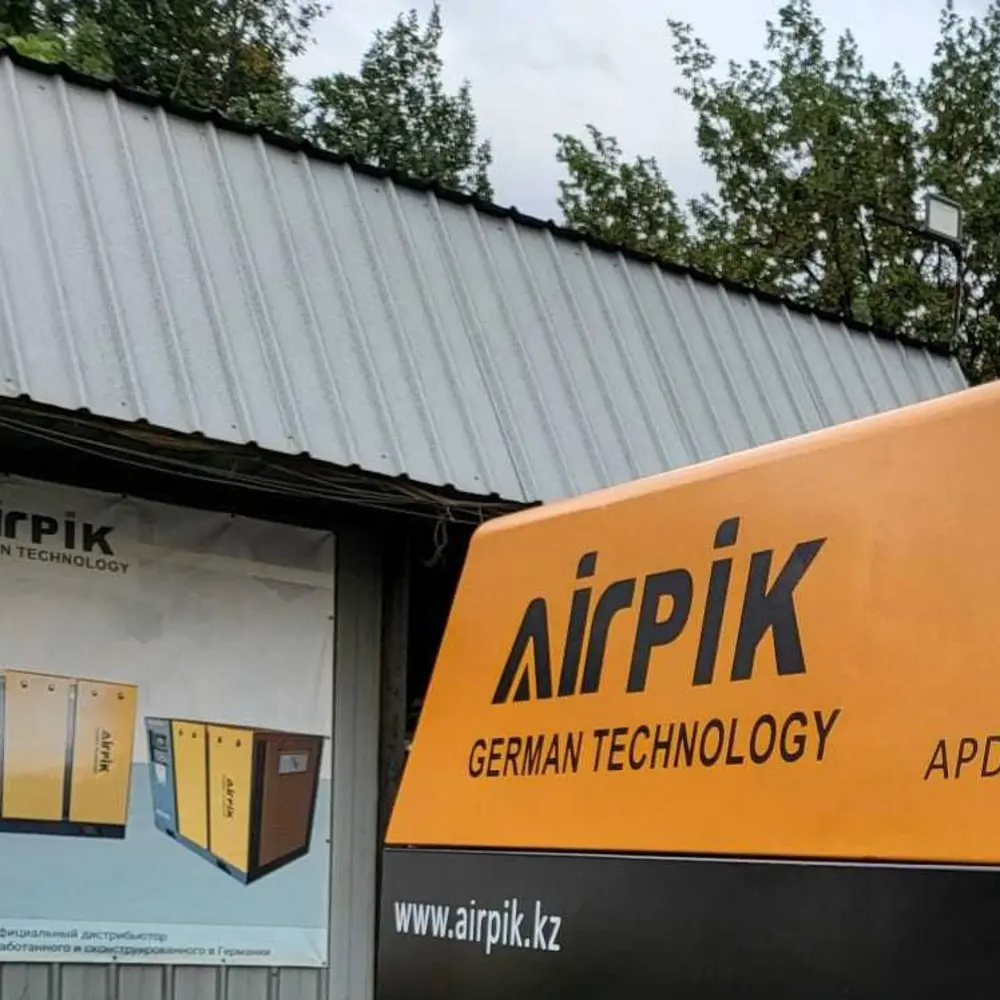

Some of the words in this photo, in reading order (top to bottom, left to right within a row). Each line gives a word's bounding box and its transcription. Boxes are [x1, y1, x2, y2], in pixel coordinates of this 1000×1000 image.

[16, 546, 130, 574] TECHNOLOGY
[468, 730, 584, 779] GERMAN
[593, 708, 841, 773] TECHNOLOGY
[394, 898, 562, 955] www.airpik.kz
